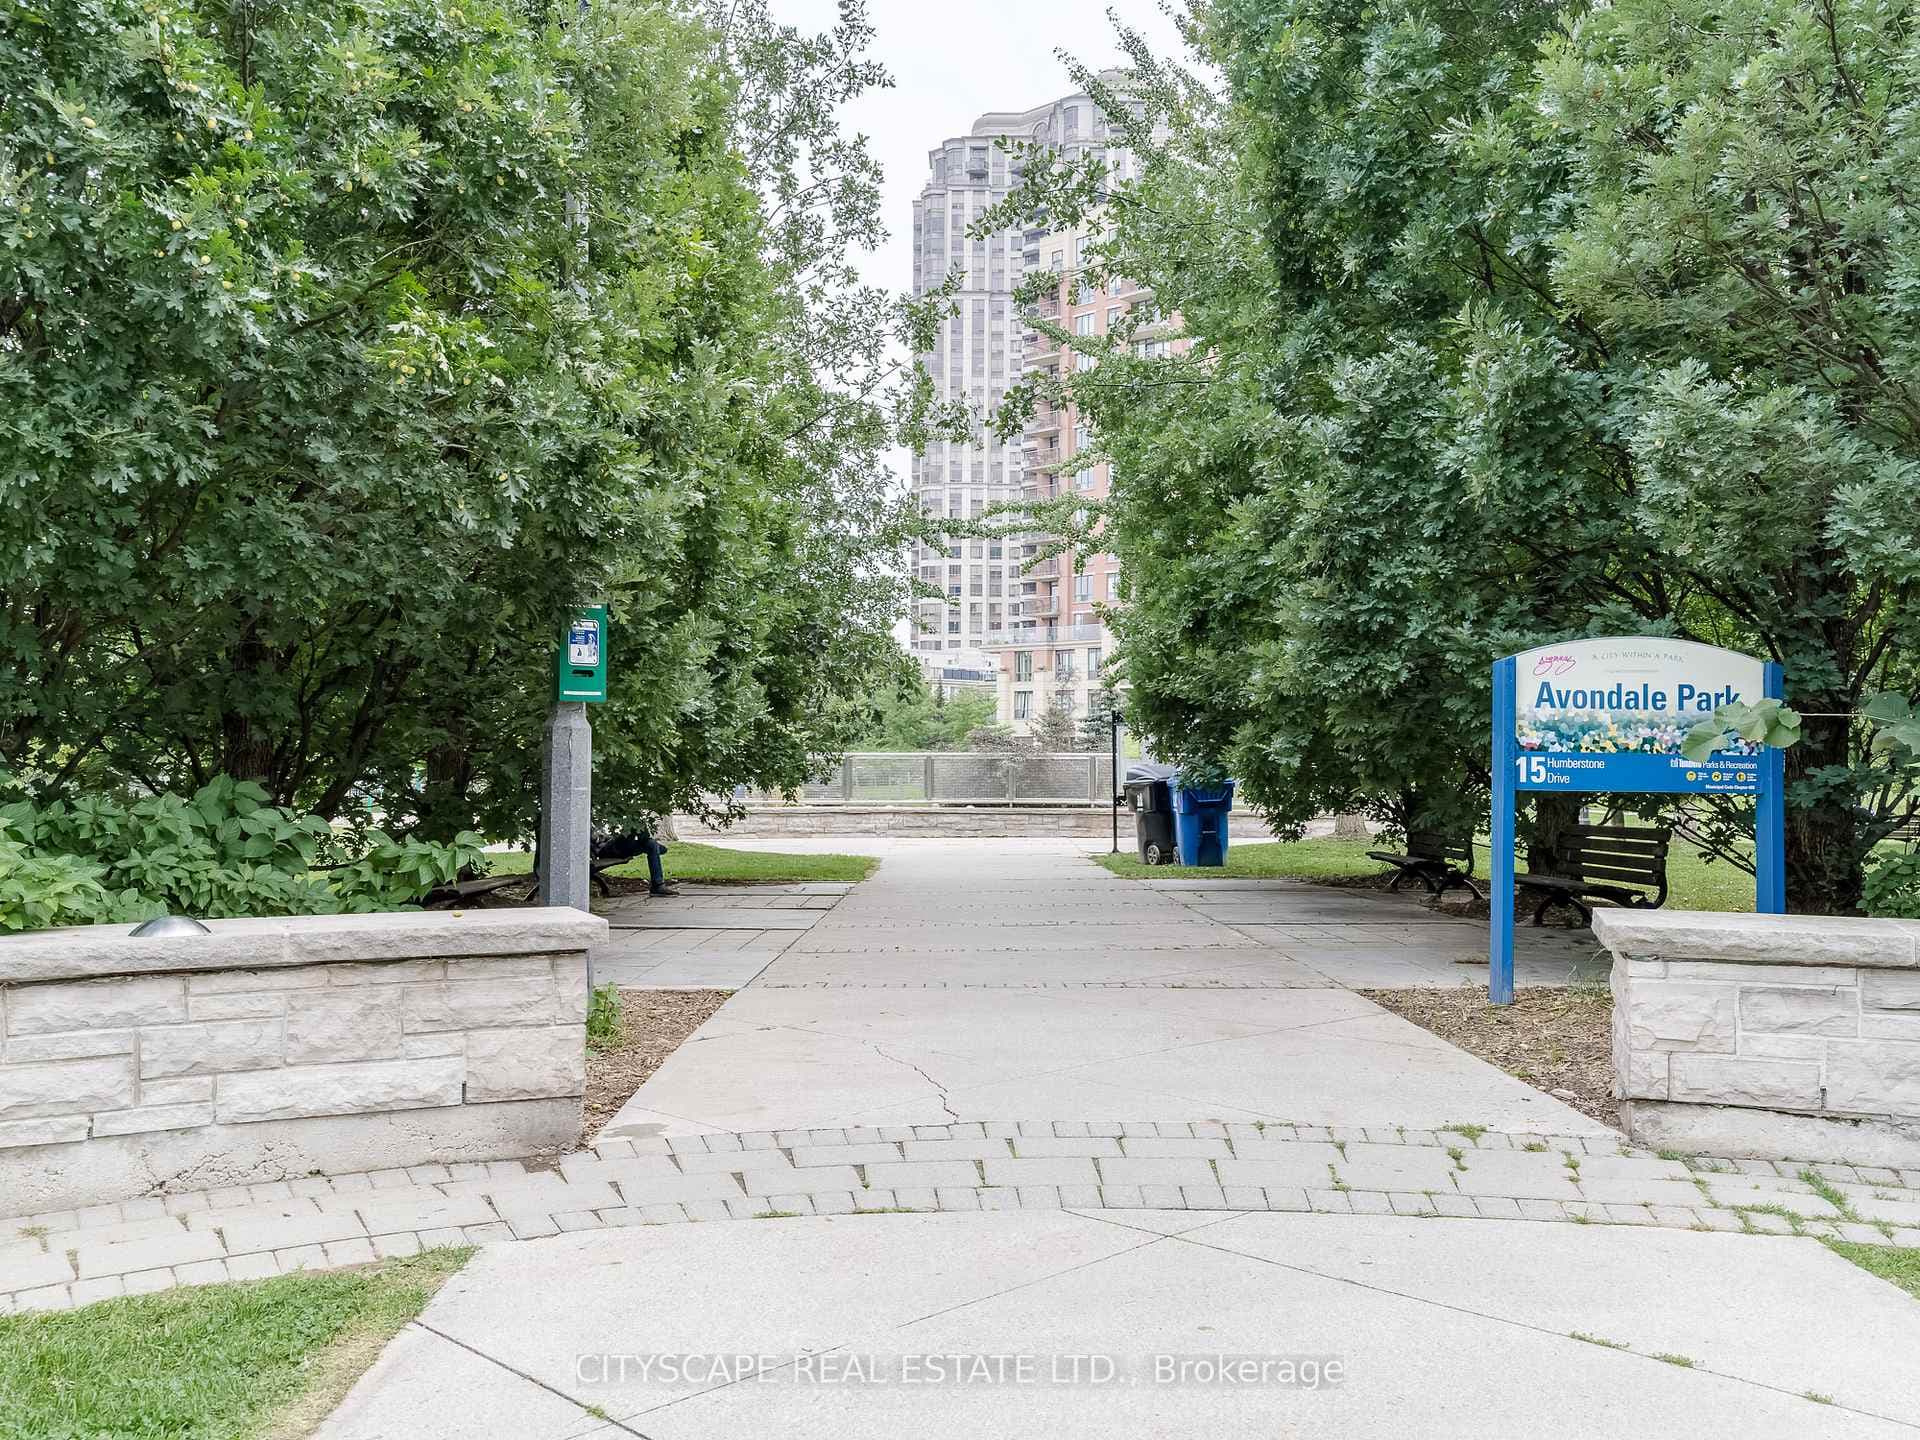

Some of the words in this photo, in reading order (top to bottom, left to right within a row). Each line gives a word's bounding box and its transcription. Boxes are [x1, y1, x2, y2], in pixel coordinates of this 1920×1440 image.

[1622, 651, 1651, 660] WITHIN
[1662, 653, 1685, 663] PARK
[1535, 681, 1667, 711] Avondale
[1677, 683, 1741, 711] Park
[1547, 757, 1605, 769] Humberstone
[1726, 760, 1758, 770] Recreation
[1515, 756, 1547, 783] 15
[1547, 772, 1570, 784] Drive
